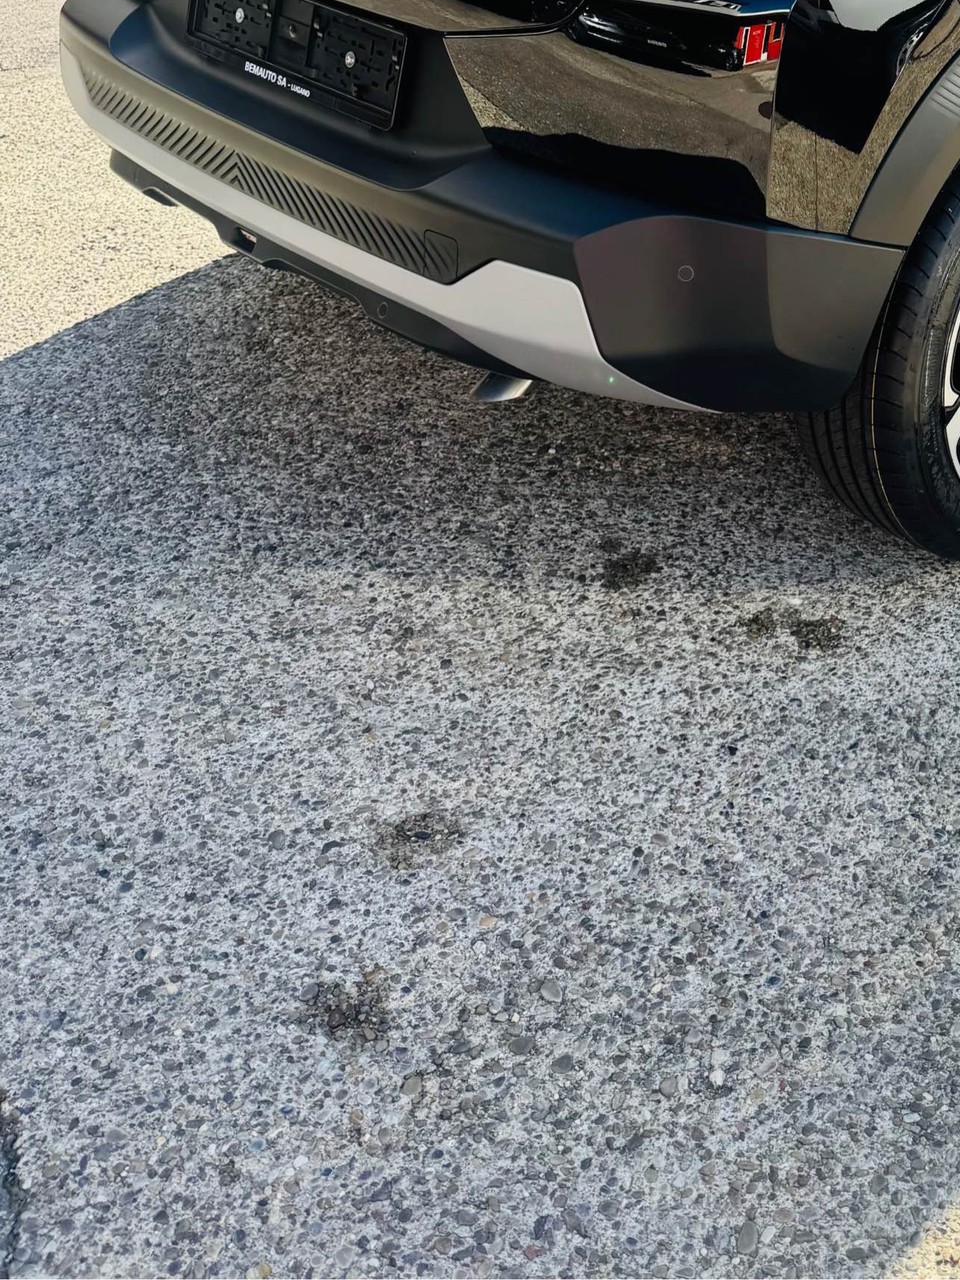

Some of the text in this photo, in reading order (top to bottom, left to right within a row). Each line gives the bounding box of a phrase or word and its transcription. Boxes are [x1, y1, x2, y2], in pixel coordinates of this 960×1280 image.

[244, 61, 277, 83] BEMAUTO
[276, 75, 287, 88] SA
[290, 83, 311, 98] LUGANO
